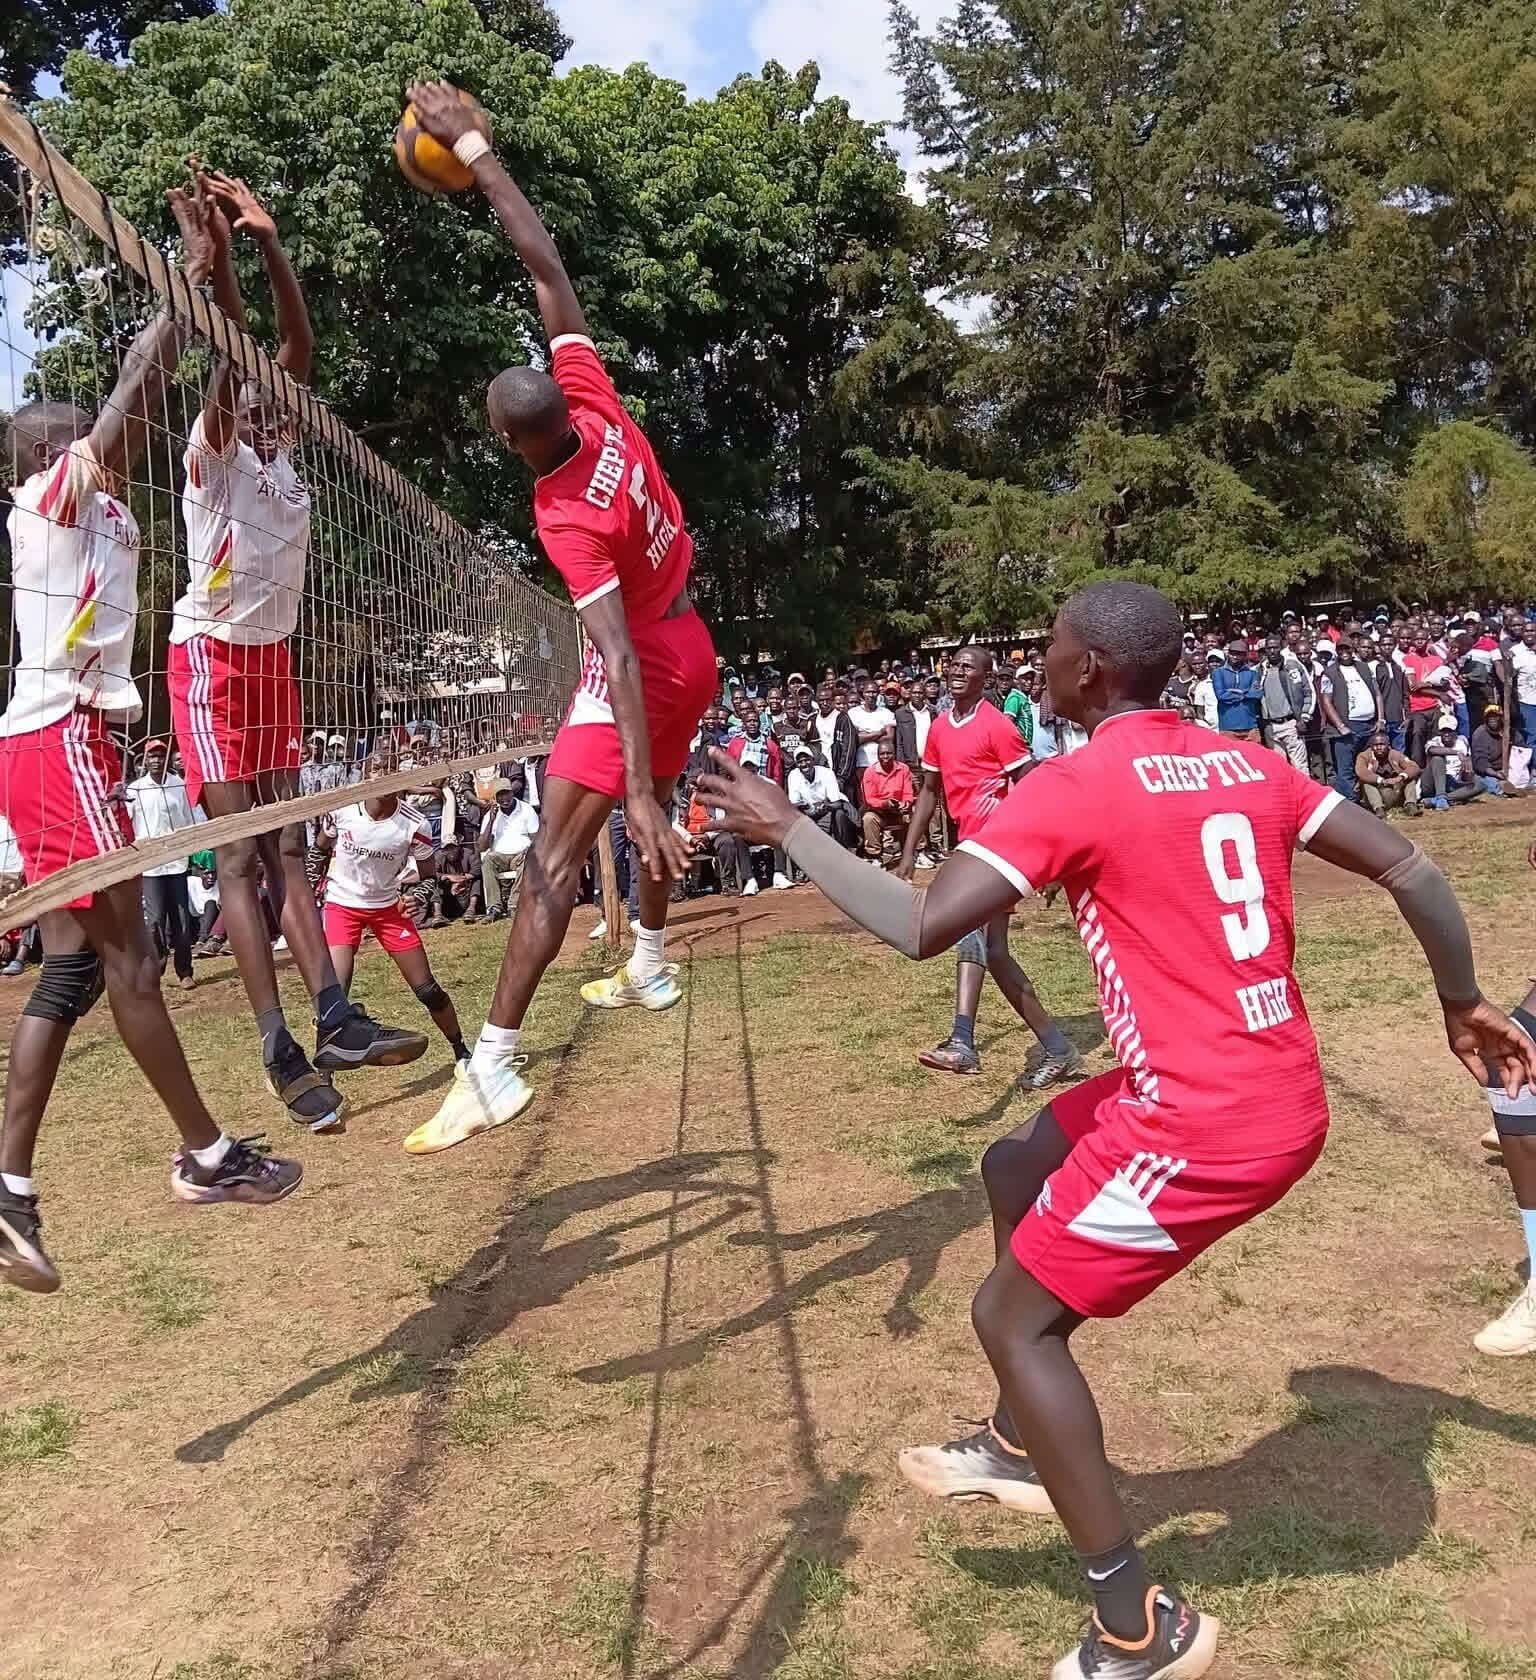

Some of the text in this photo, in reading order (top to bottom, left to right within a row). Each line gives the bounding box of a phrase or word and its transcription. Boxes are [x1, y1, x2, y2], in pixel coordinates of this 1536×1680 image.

[628, 462, 661, 538] 2
[1132, 749, 1266, 793] CHEPTIL
[342, 841, 394, 861] ATHENIANS
[1201, 812, 1271, 961] 9
